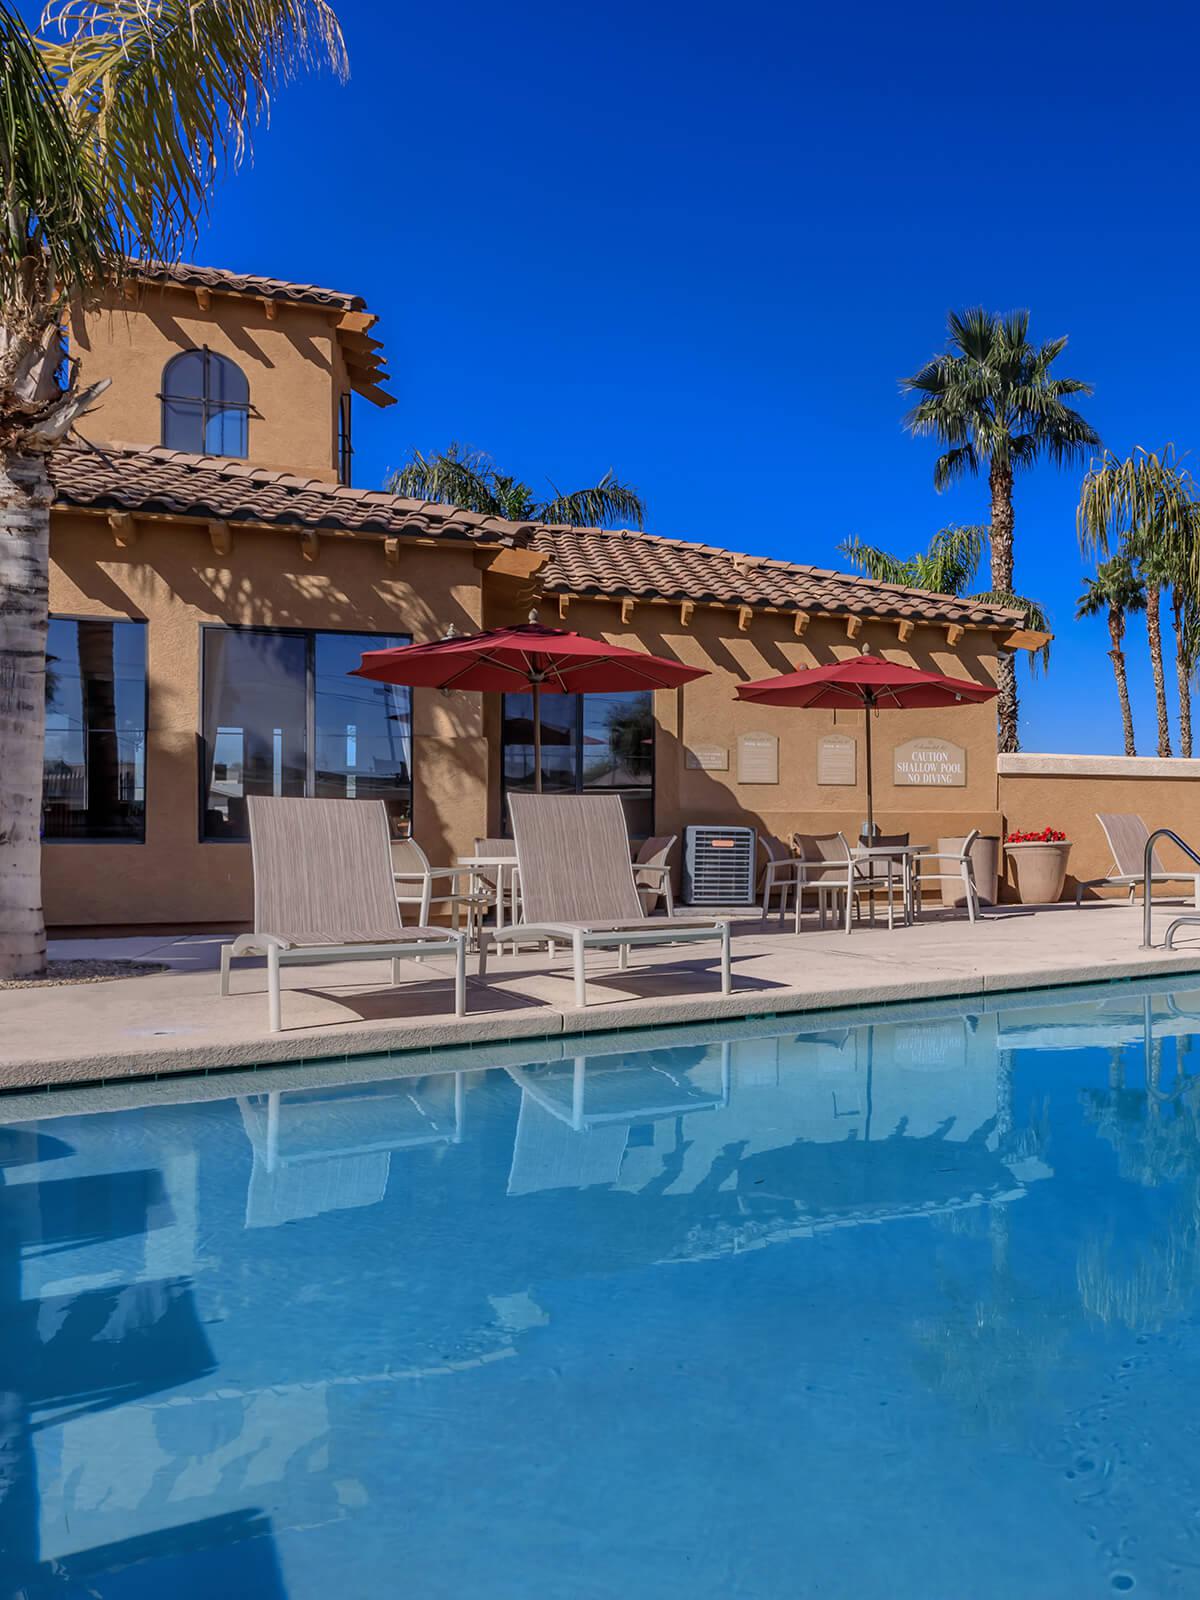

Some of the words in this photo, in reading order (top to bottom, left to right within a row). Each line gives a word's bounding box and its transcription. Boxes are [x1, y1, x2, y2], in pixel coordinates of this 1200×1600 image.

[911, 751, 949, 762] CAUTION
[896, 762, 937, 773] SHALLOW
[940, 763, 963, 774] POOL
[908, 773, 920, 784] NO
[923, 773, 953, 784] DIVING
